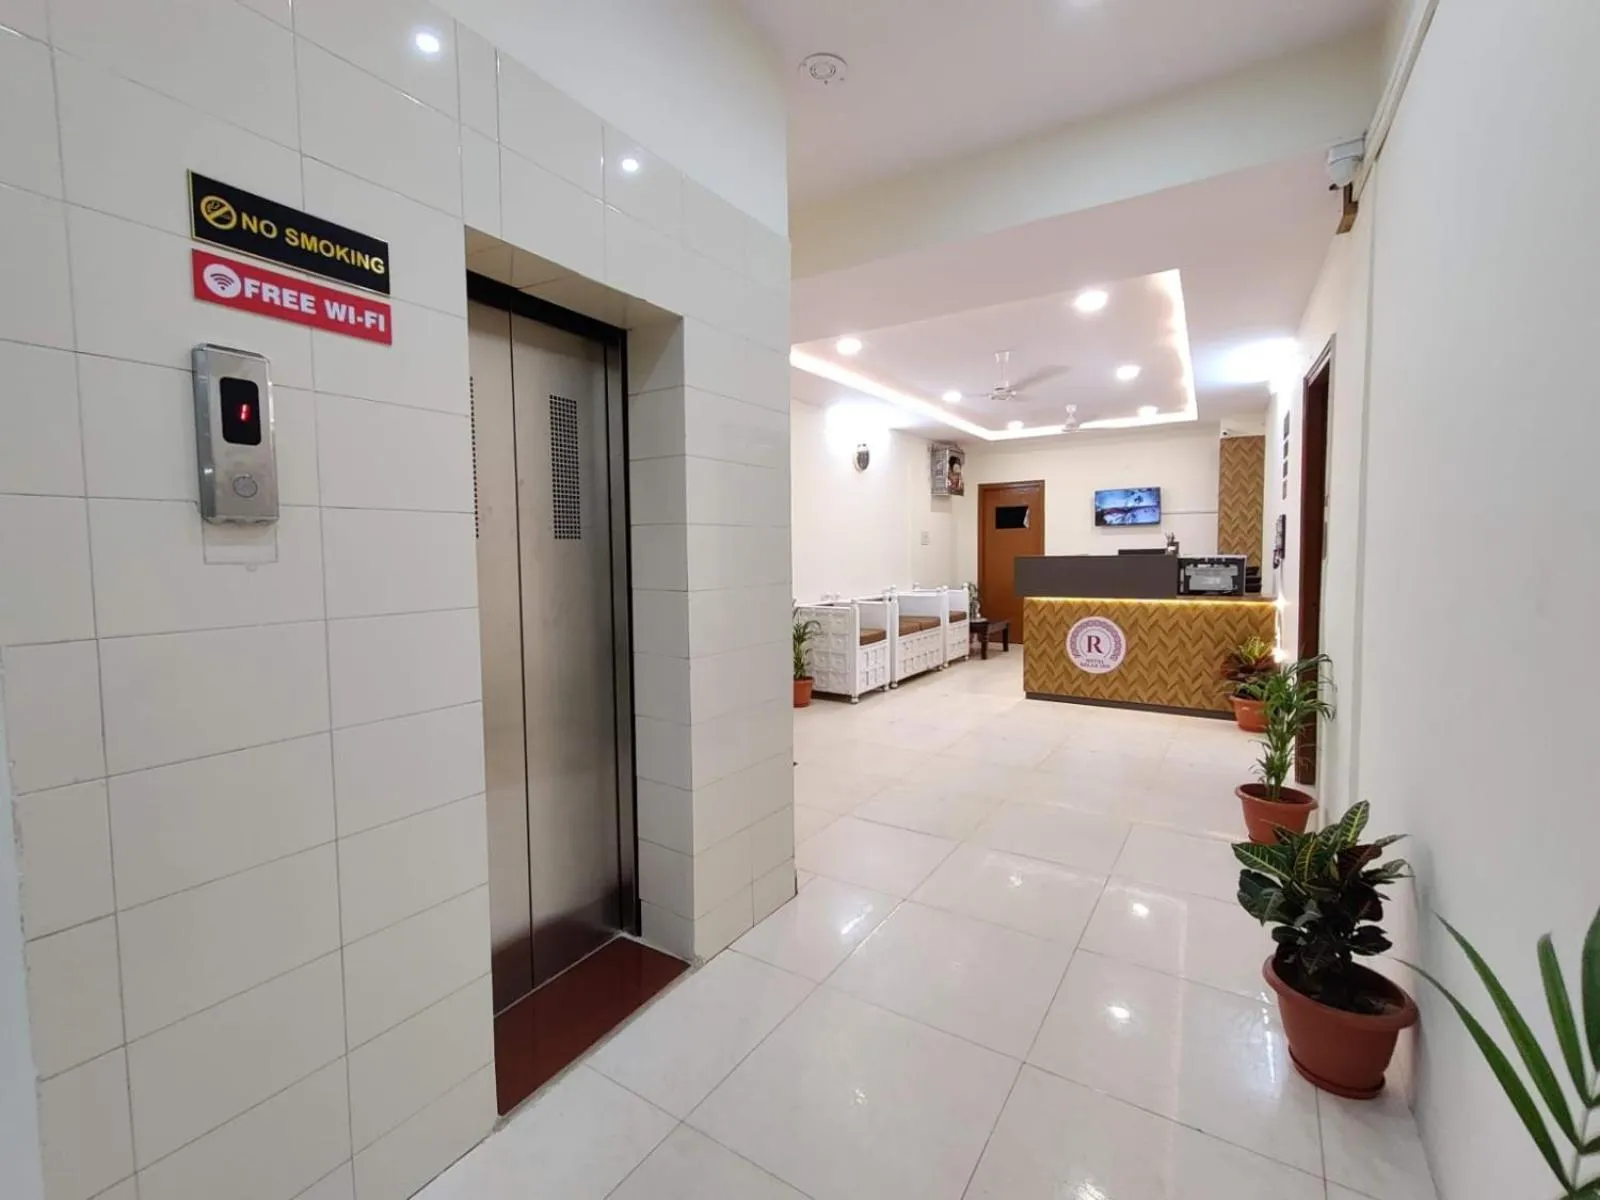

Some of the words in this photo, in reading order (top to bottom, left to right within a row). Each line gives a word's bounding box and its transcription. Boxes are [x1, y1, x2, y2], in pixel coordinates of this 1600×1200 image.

[241, 211, 278, 239] NO
[285, 227, 385, 275] SMOKING
[243, 277, 316, 315] FREE
[324, 298, 385, 332] WI-FI
[1086, 635, 1104, 654] R
